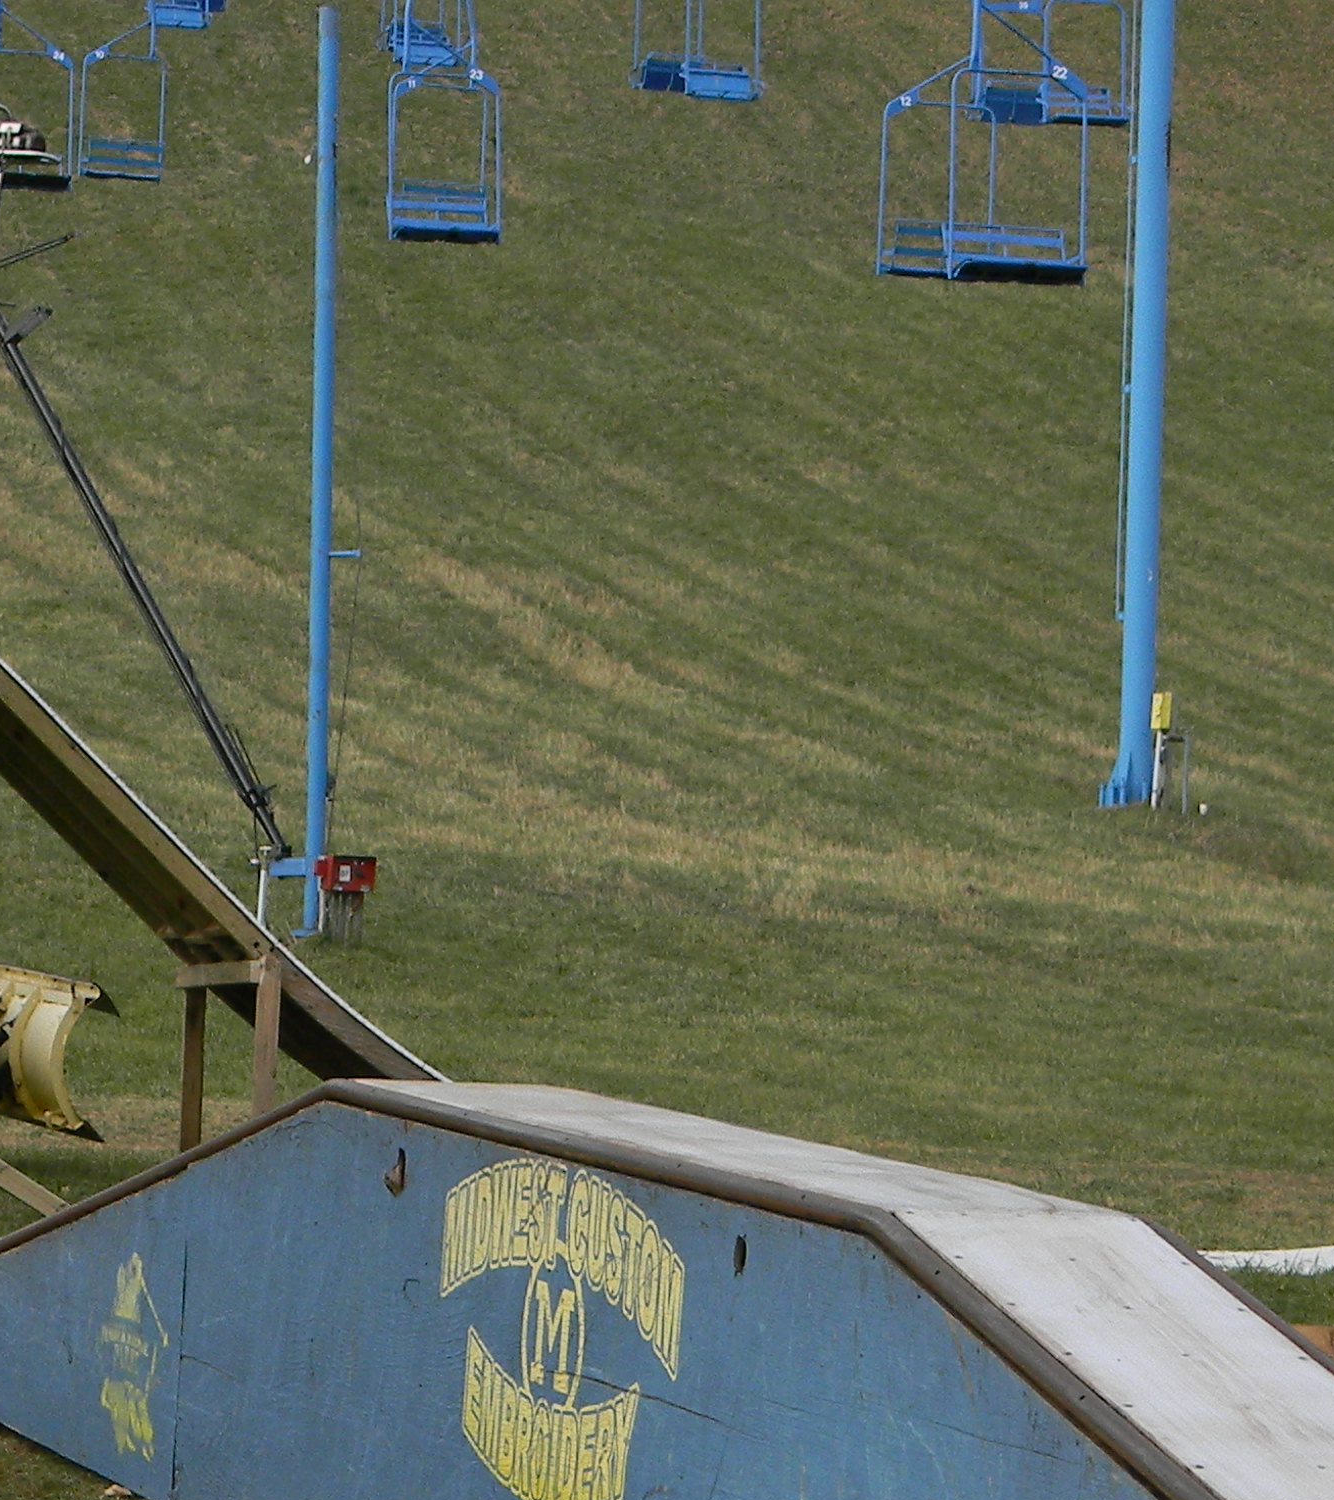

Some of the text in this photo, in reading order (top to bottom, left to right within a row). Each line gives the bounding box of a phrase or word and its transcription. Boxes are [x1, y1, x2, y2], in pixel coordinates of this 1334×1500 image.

[469, 68, 485, 80] 23
[1052, 65, 1068, 80] 22
[407, 80, 416, 89] 11
[900, 96, 912, 107] 12
[440, 1158, 685, 1381] MIDWEST CUSTOM
[529, 1279, 575, 1395] M
